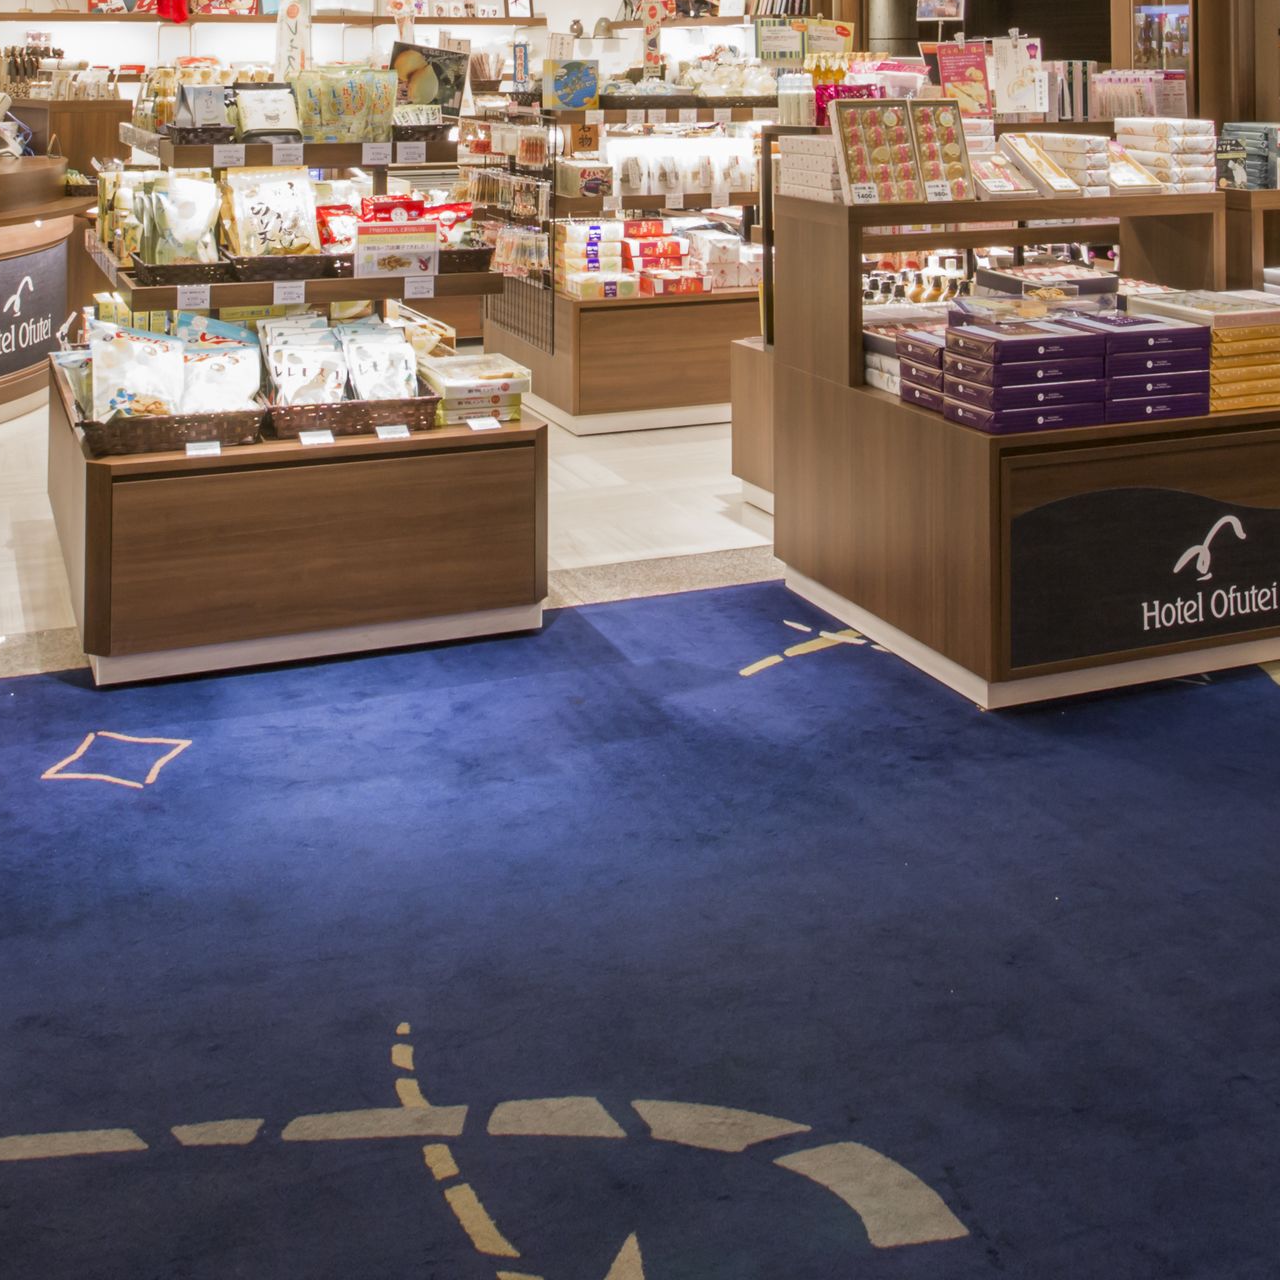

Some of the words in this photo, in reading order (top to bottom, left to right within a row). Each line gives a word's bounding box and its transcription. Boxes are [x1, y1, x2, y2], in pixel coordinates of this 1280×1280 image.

[19, 313, 52, 349] Ofutei
[1141, 590, 1204, 631] Hotel
[1210, 582, 1279, 619] Ofutei
